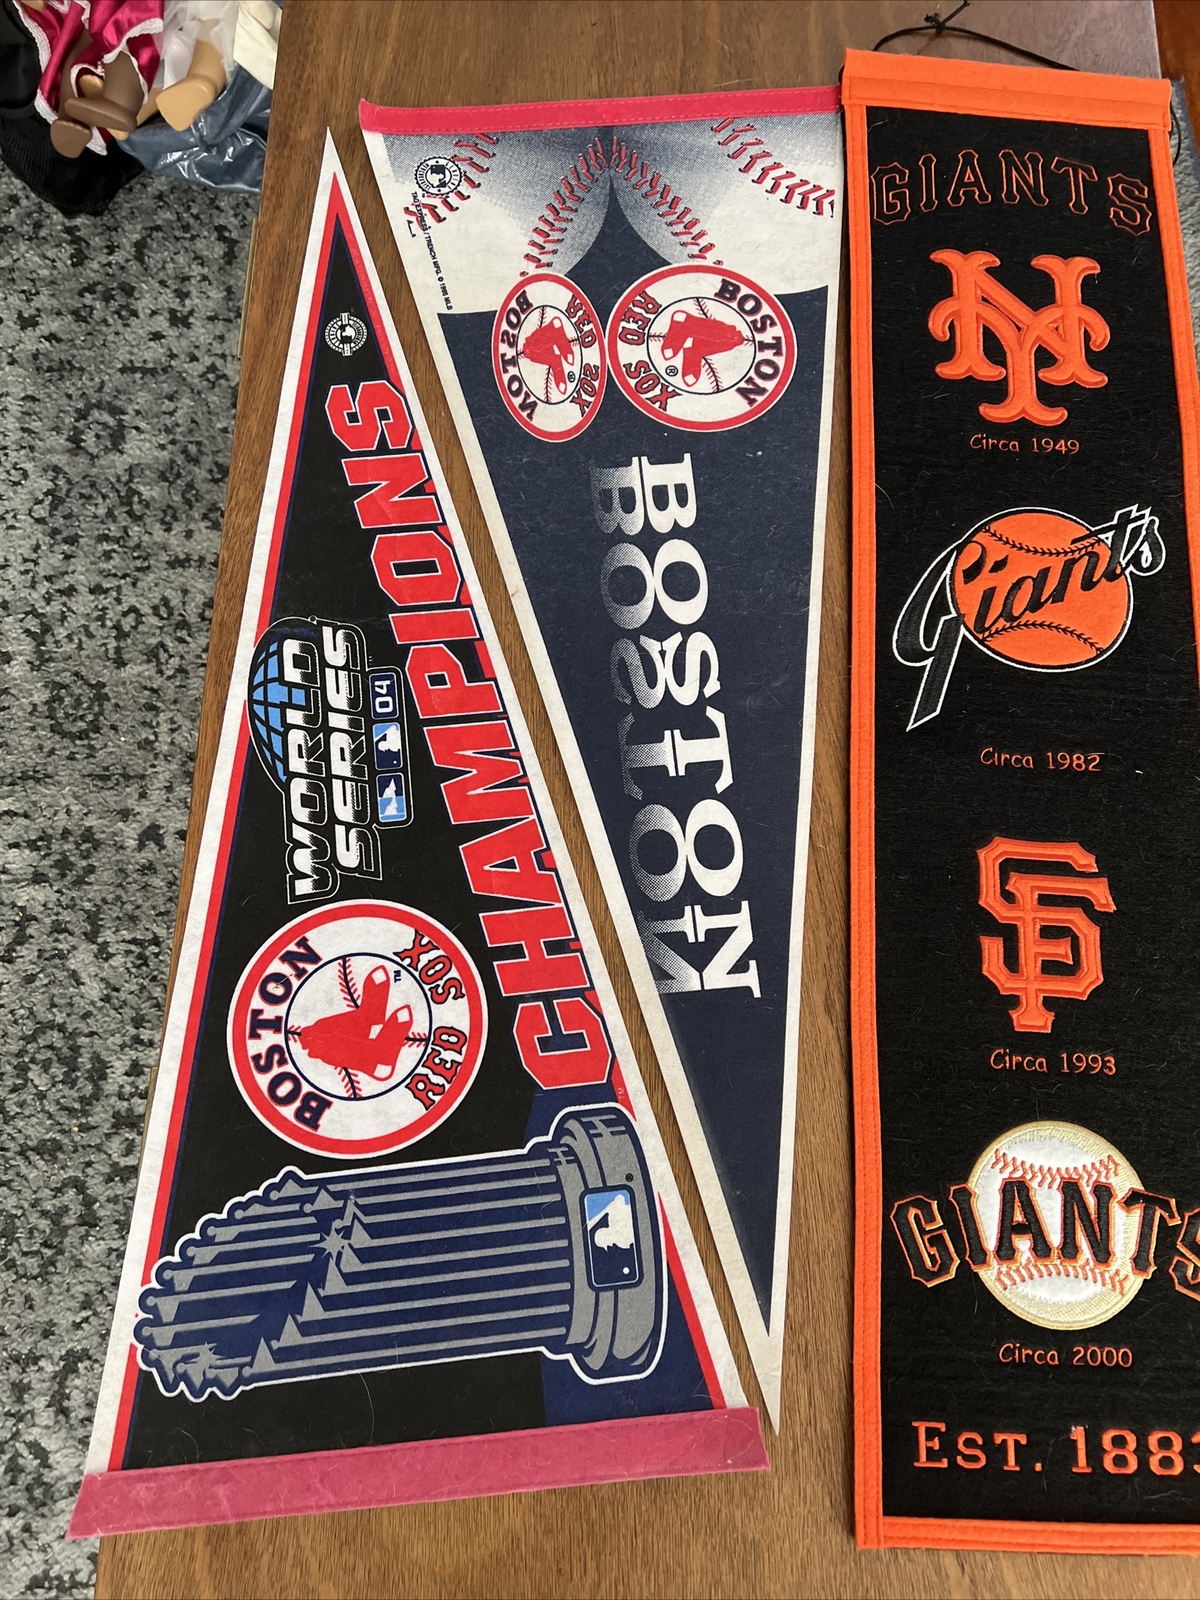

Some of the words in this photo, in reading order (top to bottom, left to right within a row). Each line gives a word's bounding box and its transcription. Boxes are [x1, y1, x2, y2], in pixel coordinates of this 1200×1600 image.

[871, 149, 1152, 236] GIANTS
[425, 235, 437, 260] TRENCH
[444, 296, 453, 310] MLB
[618, 291, 662, 346] RED
[714, 278, 783, 408] BOSTON
[623, 360, 682, 411] SOX
[970, 434, 1020, 452] Circa
[1031, 437, 1080, 455] 1949
[893, 503, 1166, 732] Giants
[325, 379, 612, 1090] CHAMPIONS
[375, 680, 394, 713] 04
[641, 452, 762, 998] BOSTON
[282, 638, 333, 896] WORLD
[322, 626, 374, 871] SERIES
[980, 747, 1034, 769] Circa
[1046, 752, 1102, 772] 1982
[393, 929, 465, 1004] SOX
[977, 836, 1117, 1033] SF
[248, 936, 333, 1132] BOSTON
[405, 1026, 467, 1111] RED
[990, 1049, 1048, 1073] Circa
[1061, 1053, 1117, 1076] 1993
[998, 1343, 1059, 1365] Circa
[1072, 1346, 1133, 1367] 2000
[1070, 1425, 1200, 1476] 188
